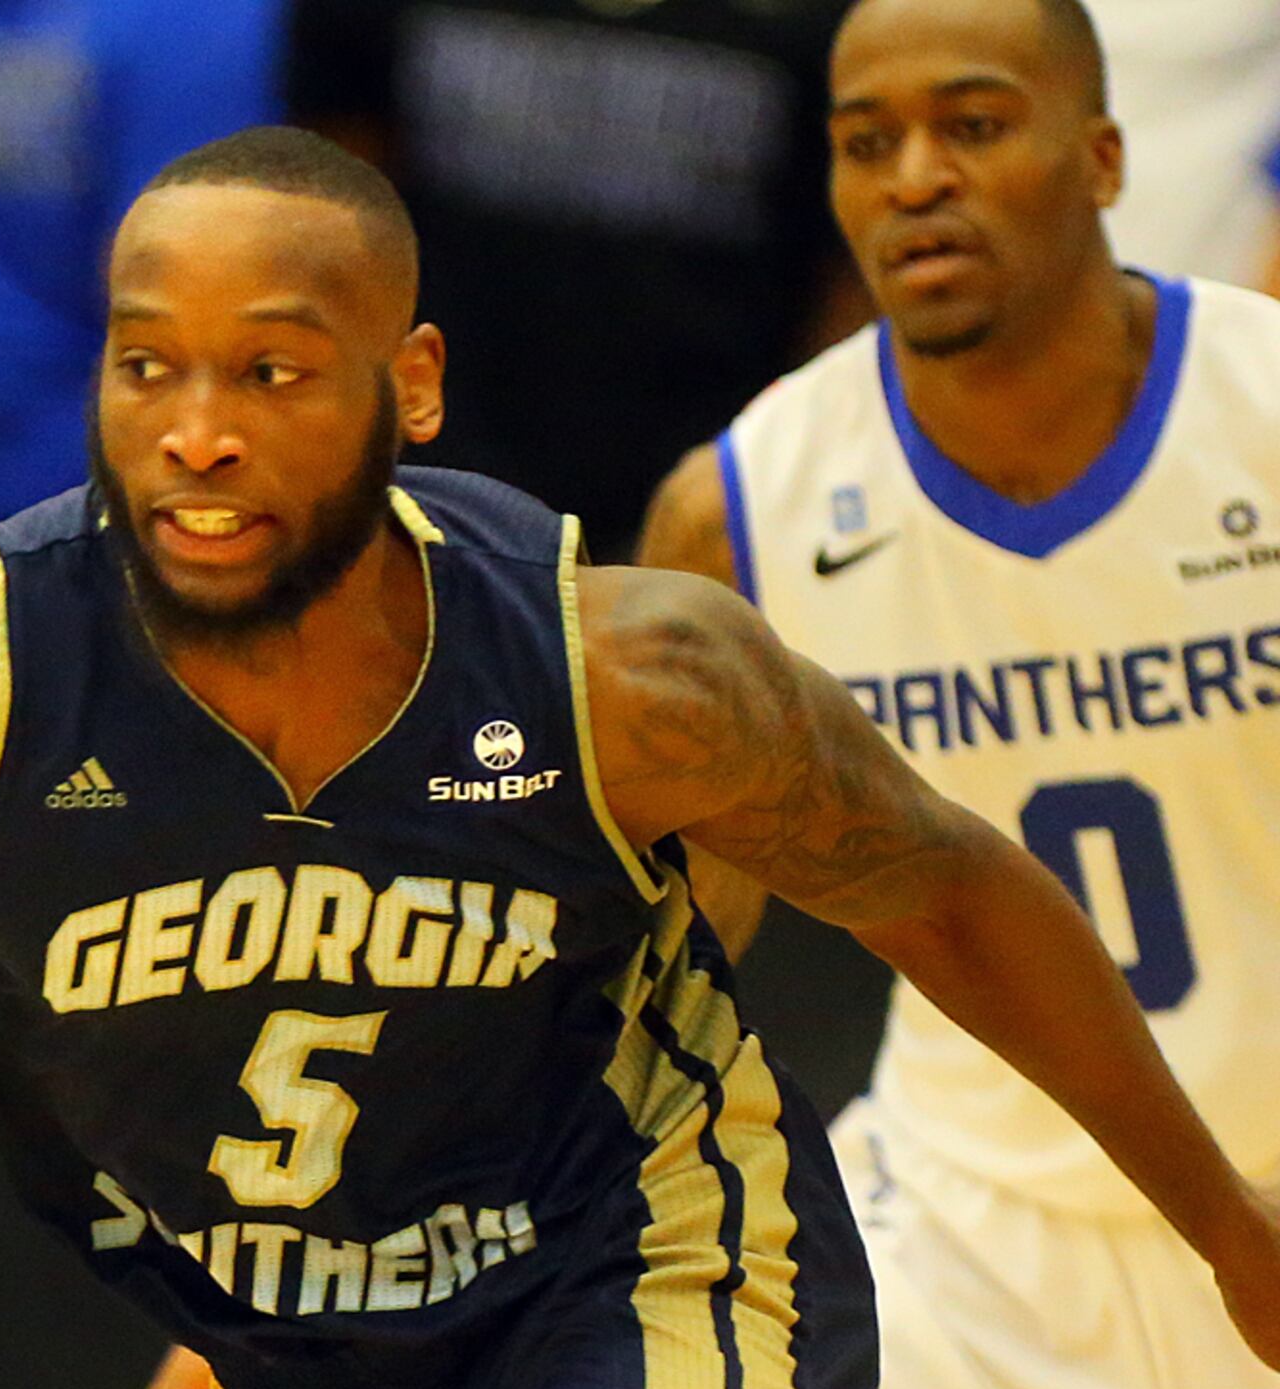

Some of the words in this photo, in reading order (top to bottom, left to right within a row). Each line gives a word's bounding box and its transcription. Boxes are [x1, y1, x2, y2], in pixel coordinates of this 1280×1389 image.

[45, 789, 128, 809] adidas
[429, 776, 495, 801] SUN
[43, 864, 557, 1013] GEORGIA
[208, 1009, 389, 1208] 5
